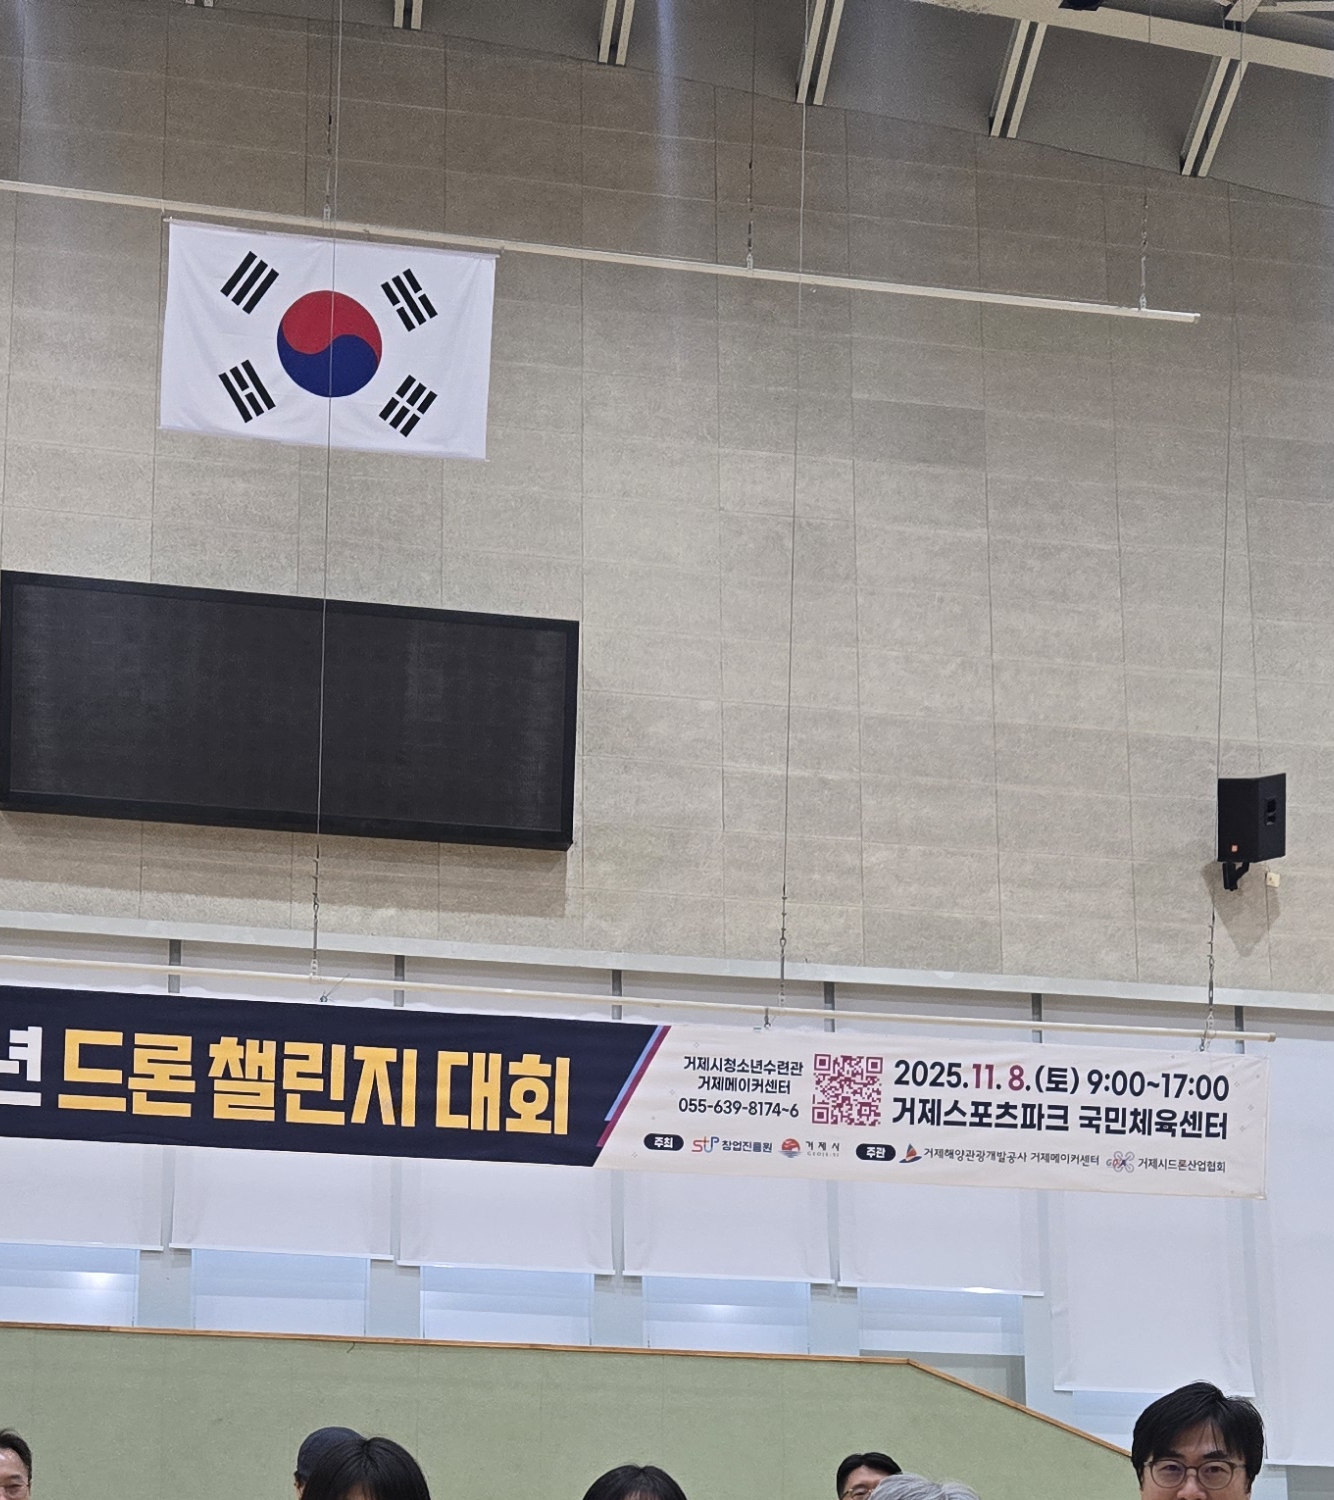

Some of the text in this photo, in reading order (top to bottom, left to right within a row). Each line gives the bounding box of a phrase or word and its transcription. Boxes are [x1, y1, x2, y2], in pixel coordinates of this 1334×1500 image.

[683, 1055, 804, 1077] 거제시청소년수련관
[57, 1027, 197, 1119] 드론
[207, 1034, 419, 1128] 챌린지
[434, 1049, 571, 1136] 대회
[697, 1075, 792, 1095] 거제메이커센터
[1086, 1068, 1230, 1102] 9:00~17:00
[678, 1097, 800, 1118] 055-639-8174~6
[892, 1096, 1229, 1140] 거제스포츠파크 국민체육센터
[653, 1136, 674, 1149] 주최
[805, 1140, 840, 1152] 거제시
[865, 1146, 887, 1159] 주관
[1030, 1151, 1100, 1168] 거제메이커센터
[1137, 1157, 1227, 1174] 거제시드론산업협회
